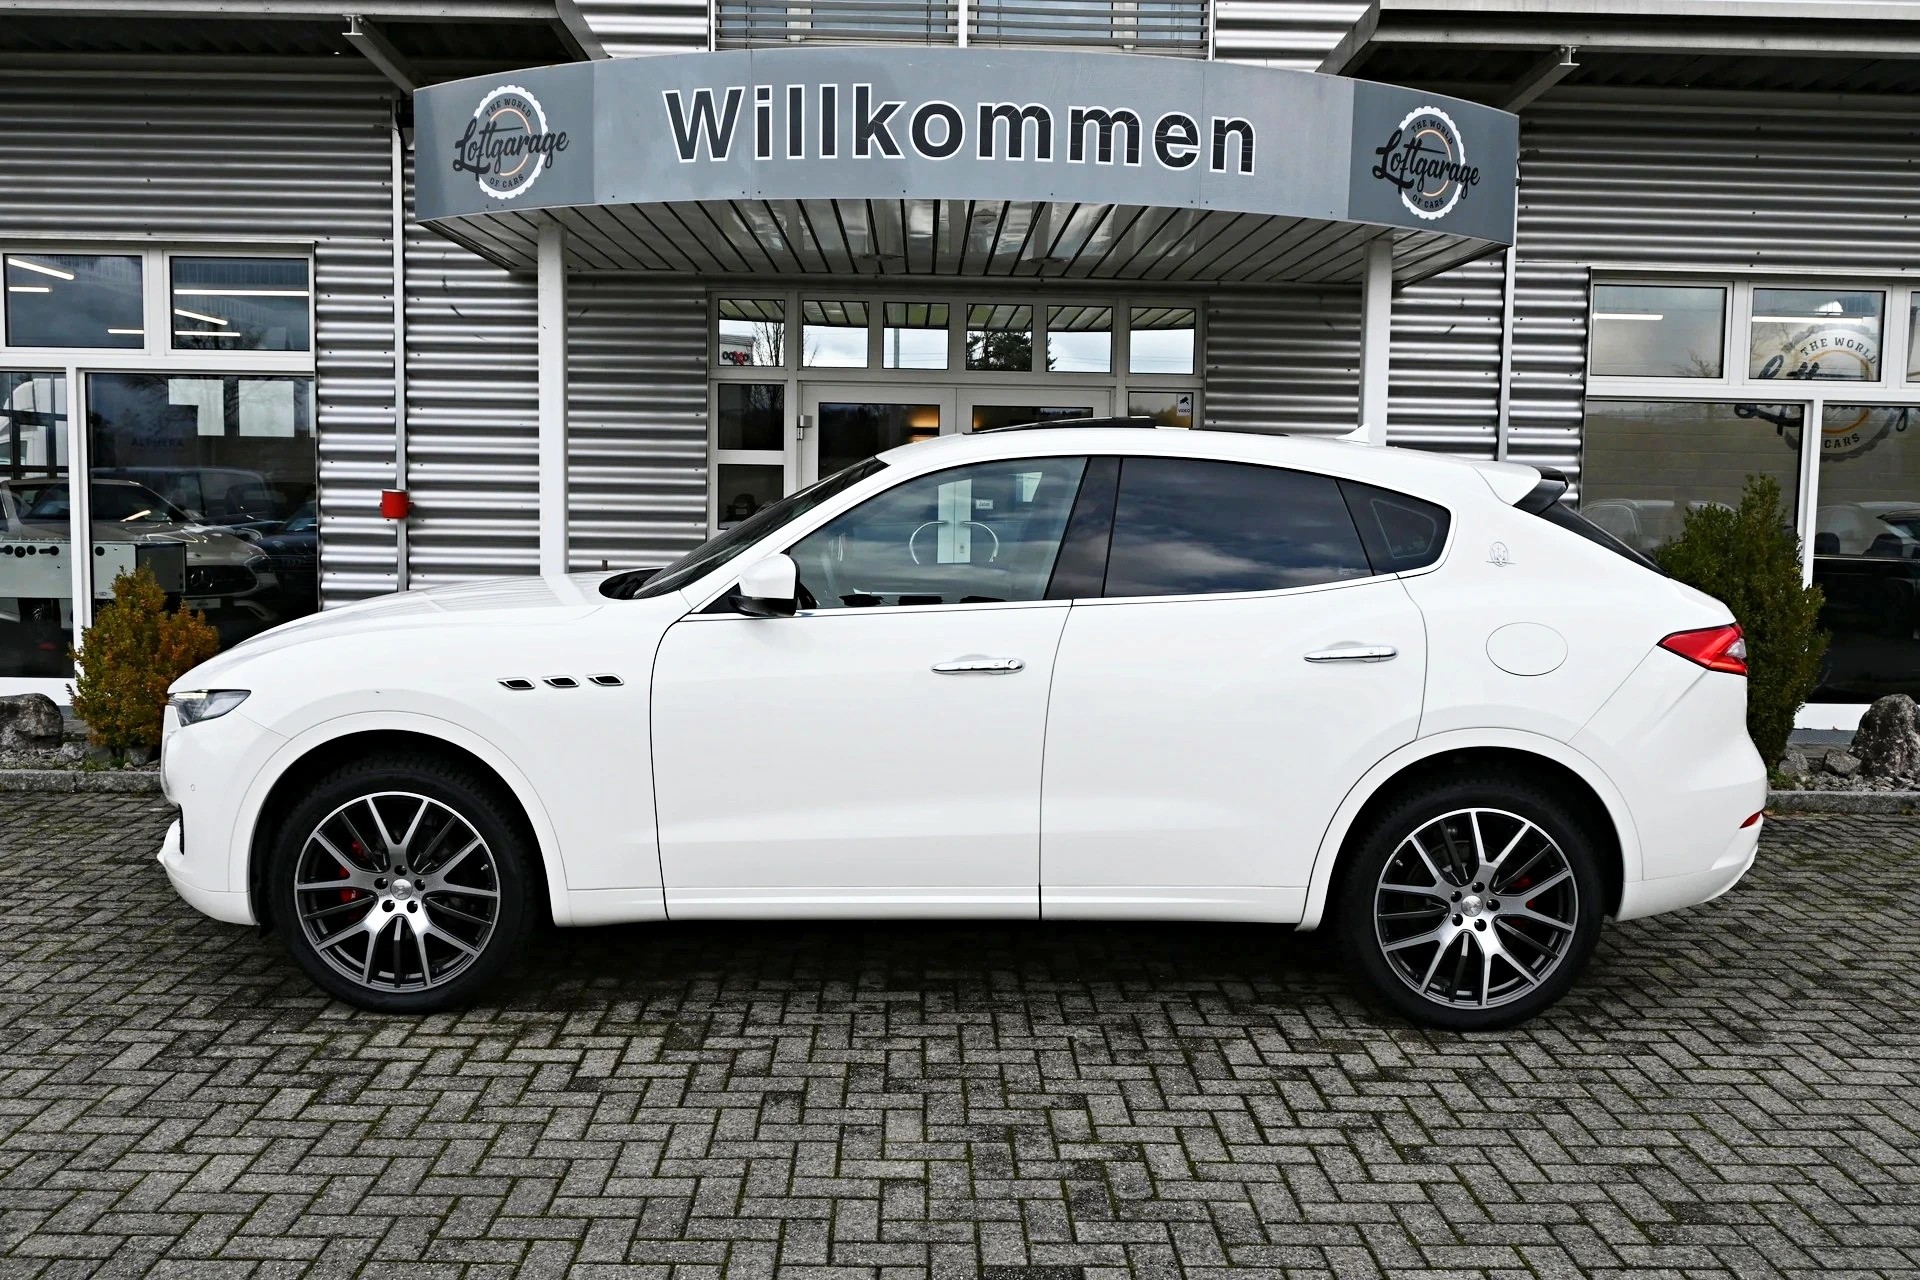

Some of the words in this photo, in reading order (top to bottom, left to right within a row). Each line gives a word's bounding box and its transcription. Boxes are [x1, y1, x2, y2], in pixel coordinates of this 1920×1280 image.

[485, 100, 502, 117] THE
[504, 98, 532, 118] WORLD
[662, 83, 1257, 176] Willkommen
[1411, 119, 1427, 133] THE
[1429, 119, 1454, 145] WORLD
[452, 116, 570, 182] Loftgarage
[1372, 129, 1481, 200] Loftgarage
[489, 177, 500, 188] OF
[502, 173, 524, 188] CARS
[1412, 194, 1422, 205] OF
[1424, 197, 1444, 209] CARS
[1800, 337, 1828, 358] THE
[1834, 336, 1877, 365] WORLD
[1824, 433, 1860, 449] CARS
